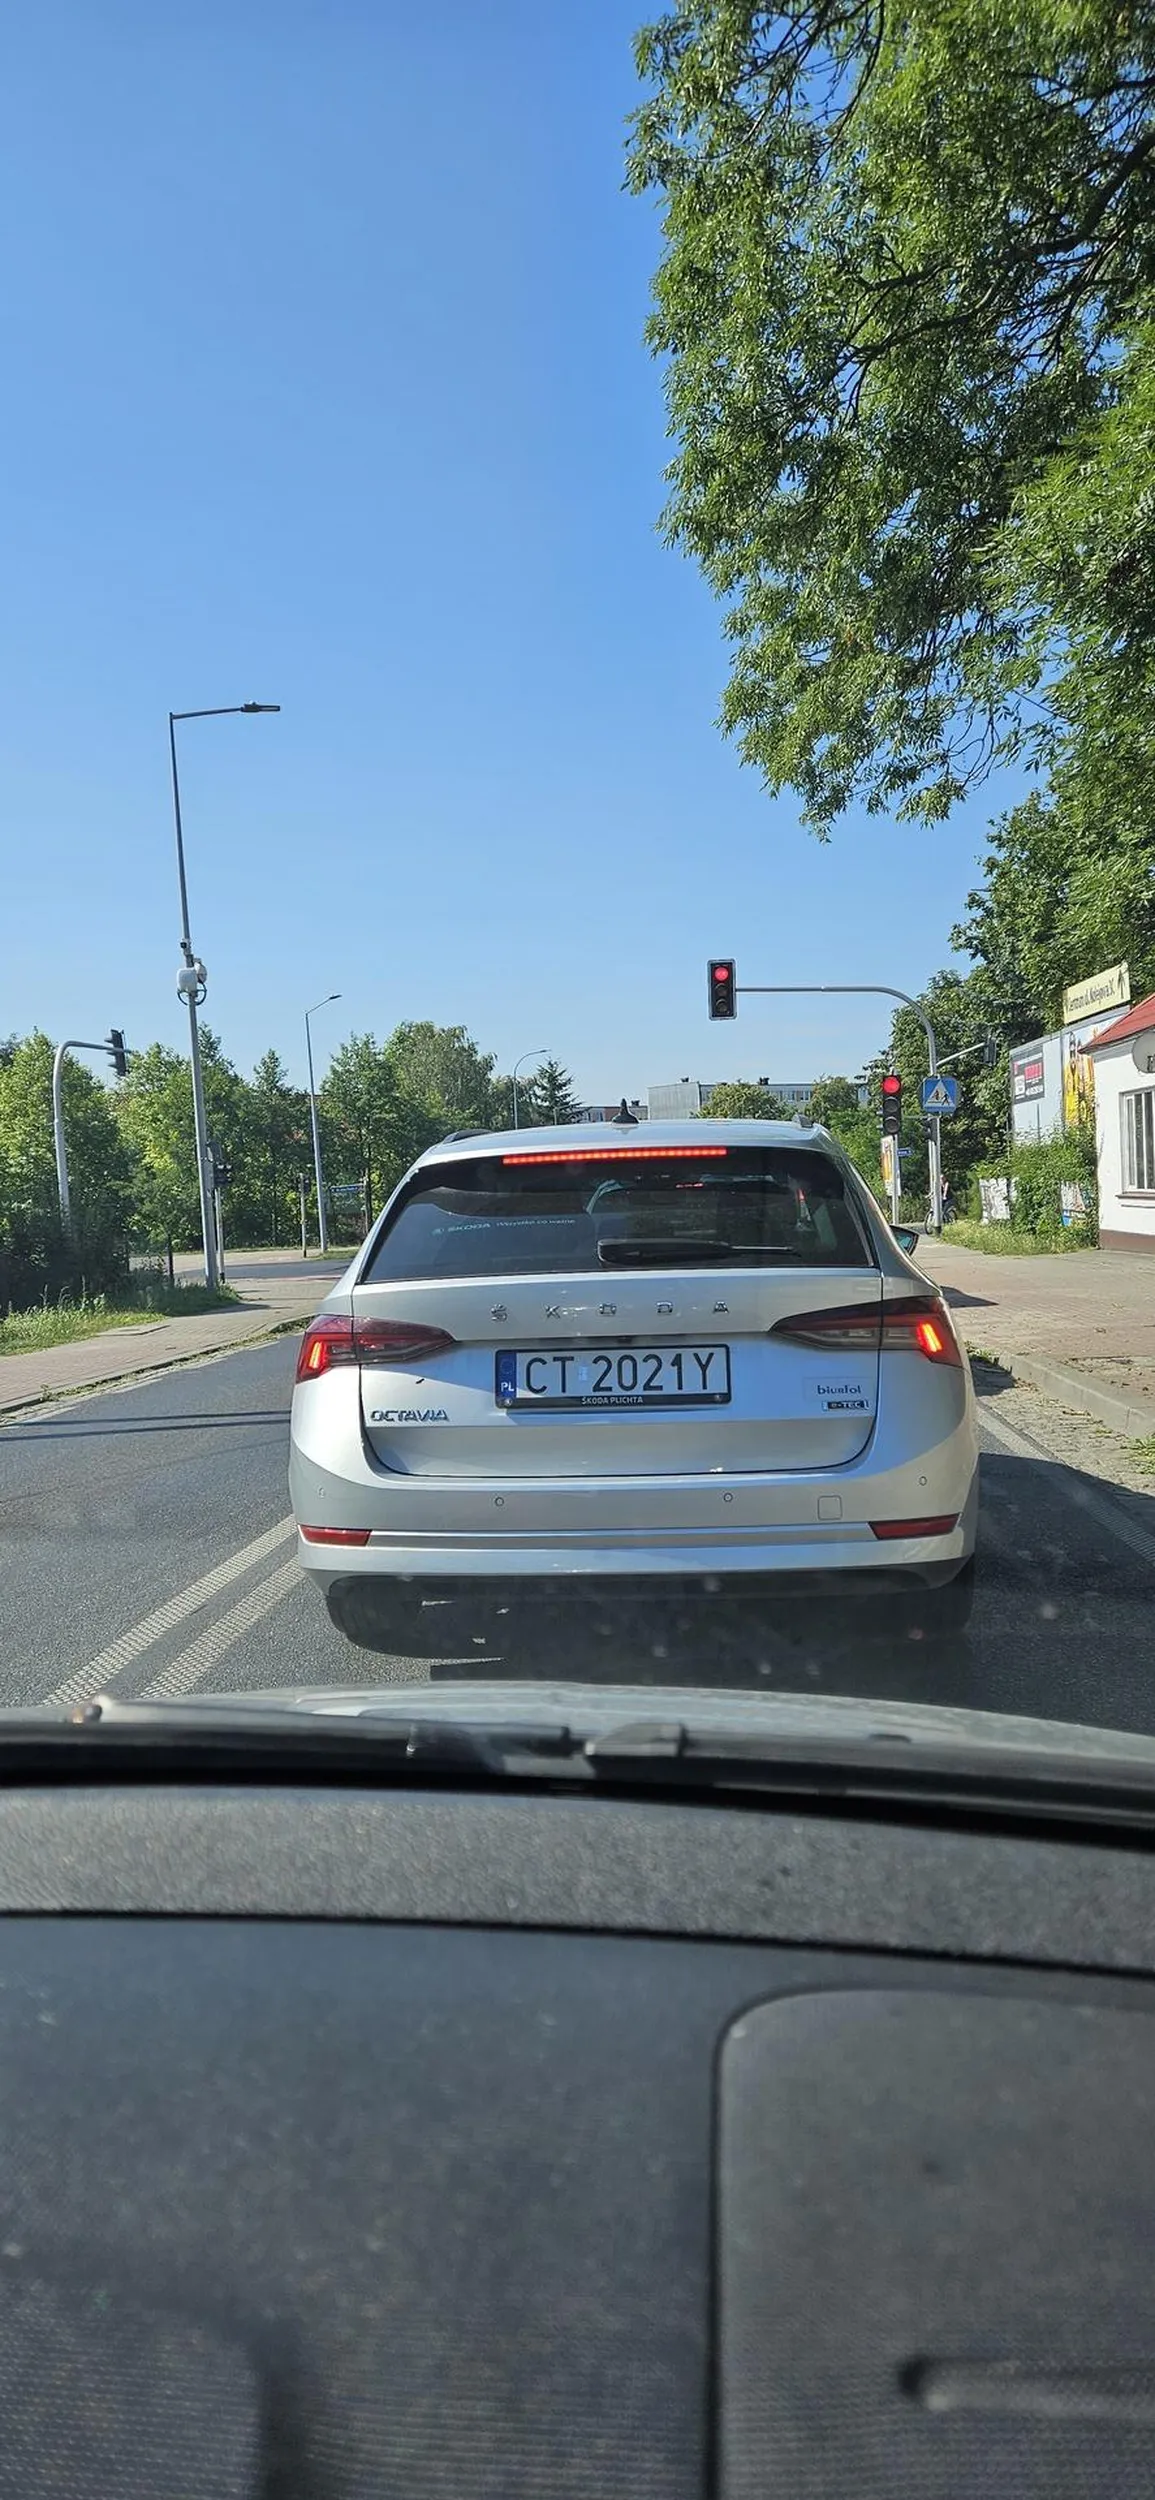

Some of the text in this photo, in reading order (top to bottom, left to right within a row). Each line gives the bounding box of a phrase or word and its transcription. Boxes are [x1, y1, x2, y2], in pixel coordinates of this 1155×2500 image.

[525, 1352, 715, 1395] CT 2021Y
[500, 1381, 515, 1392] PL
[610, 1395, 643, 1404] PLICHTA
[370, 1409, 450, 1422] OCTAVIA
